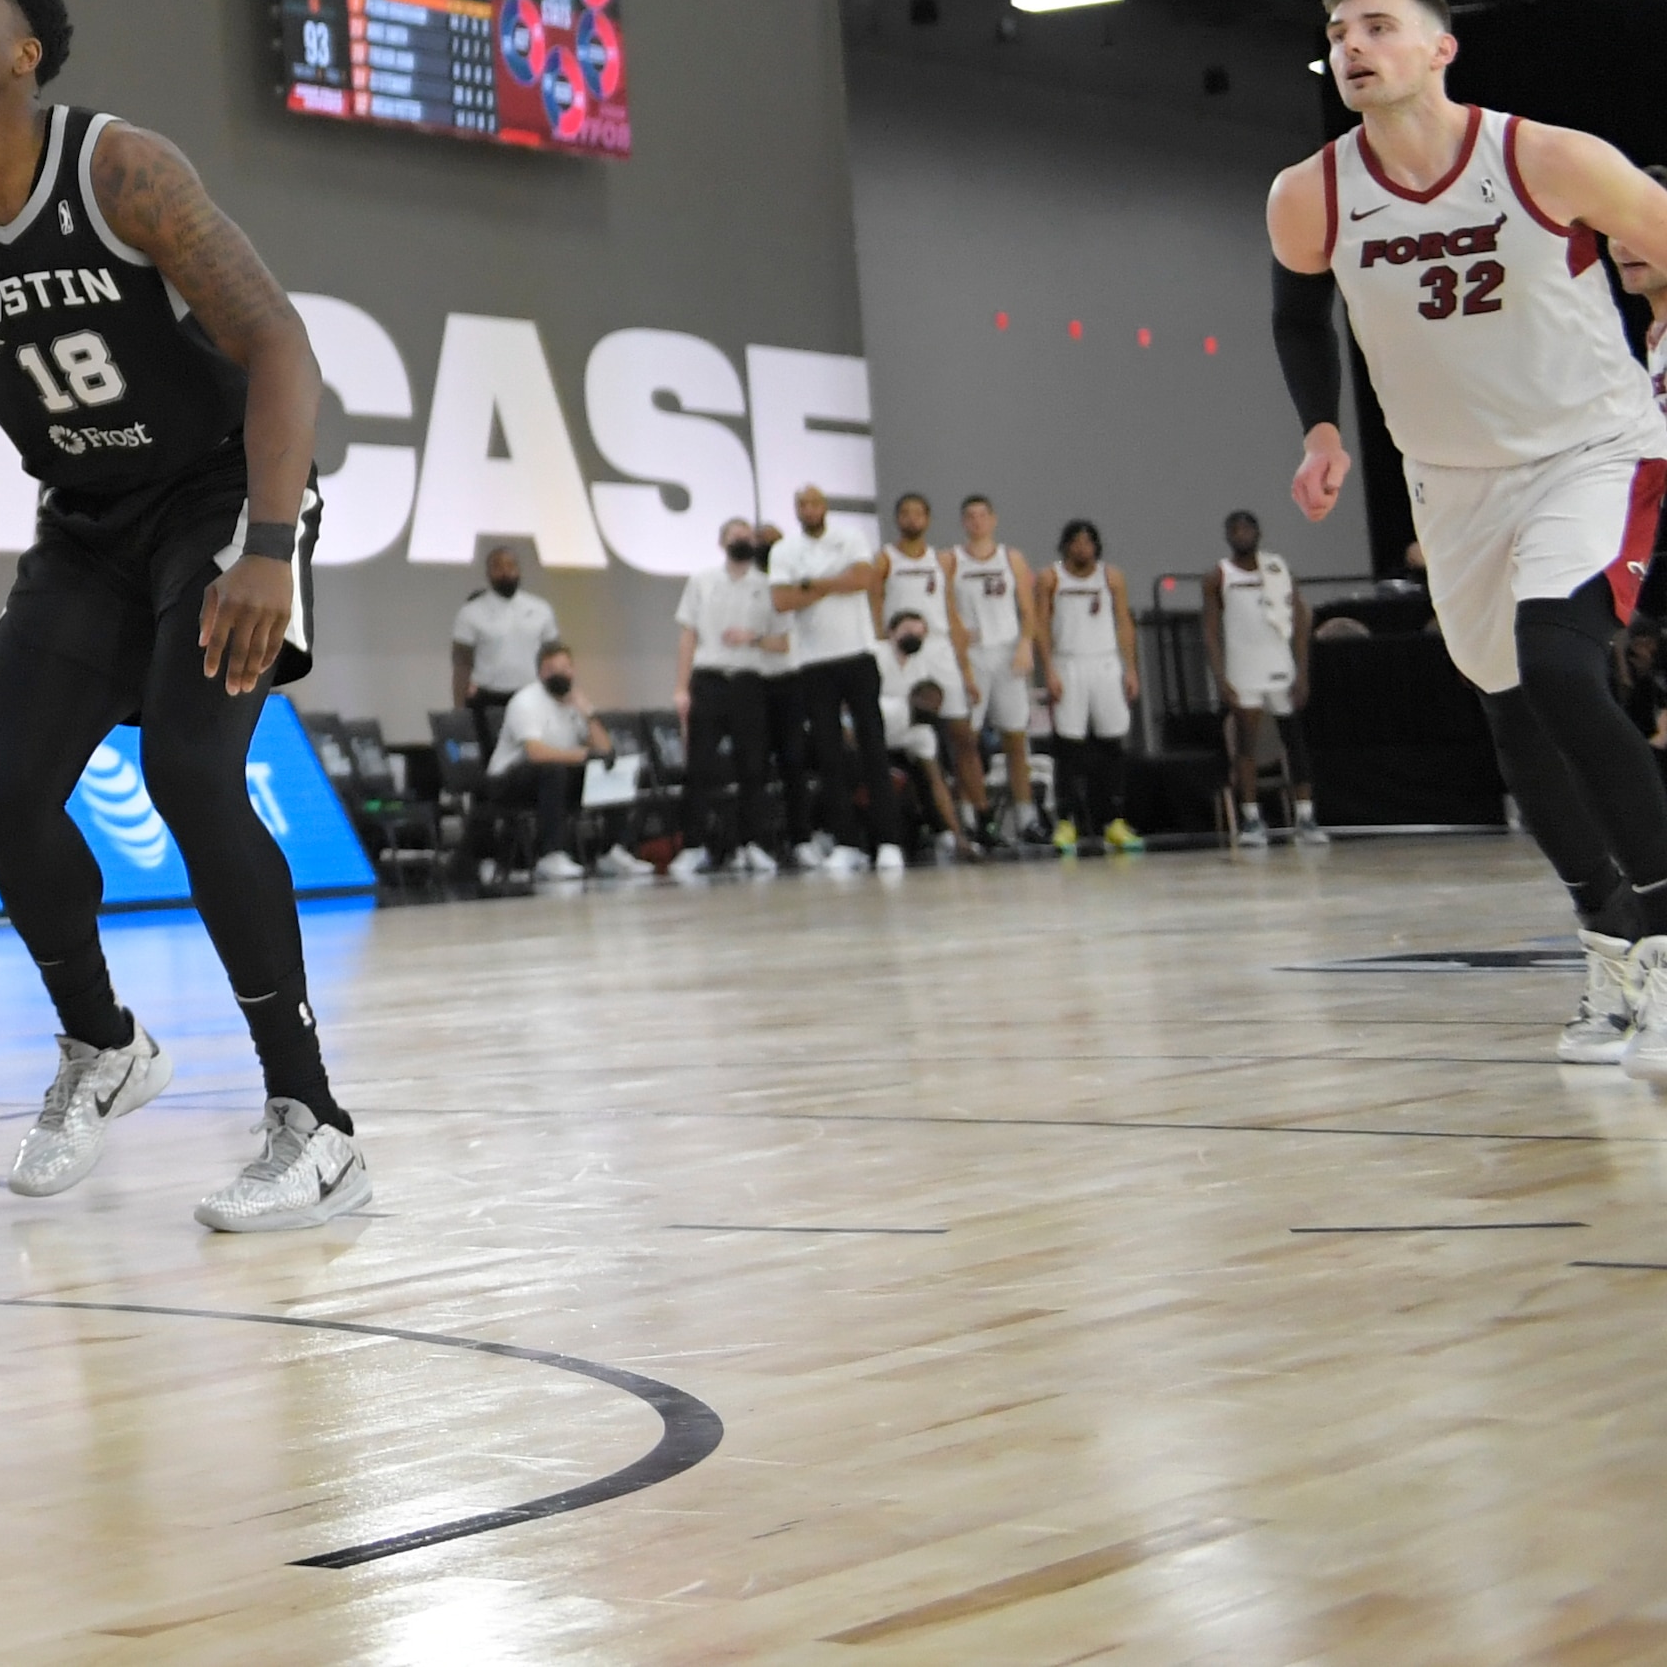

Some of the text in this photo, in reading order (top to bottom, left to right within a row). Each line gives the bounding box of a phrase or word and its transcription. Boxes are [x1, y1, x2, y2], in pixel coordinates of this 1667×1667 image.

[1359, 212, 1508, 269] FORCE
[1418, 259, 1505, 321] 32
[16, 328, 127, 413] 18
[81, 420, 154, 449] Frost
